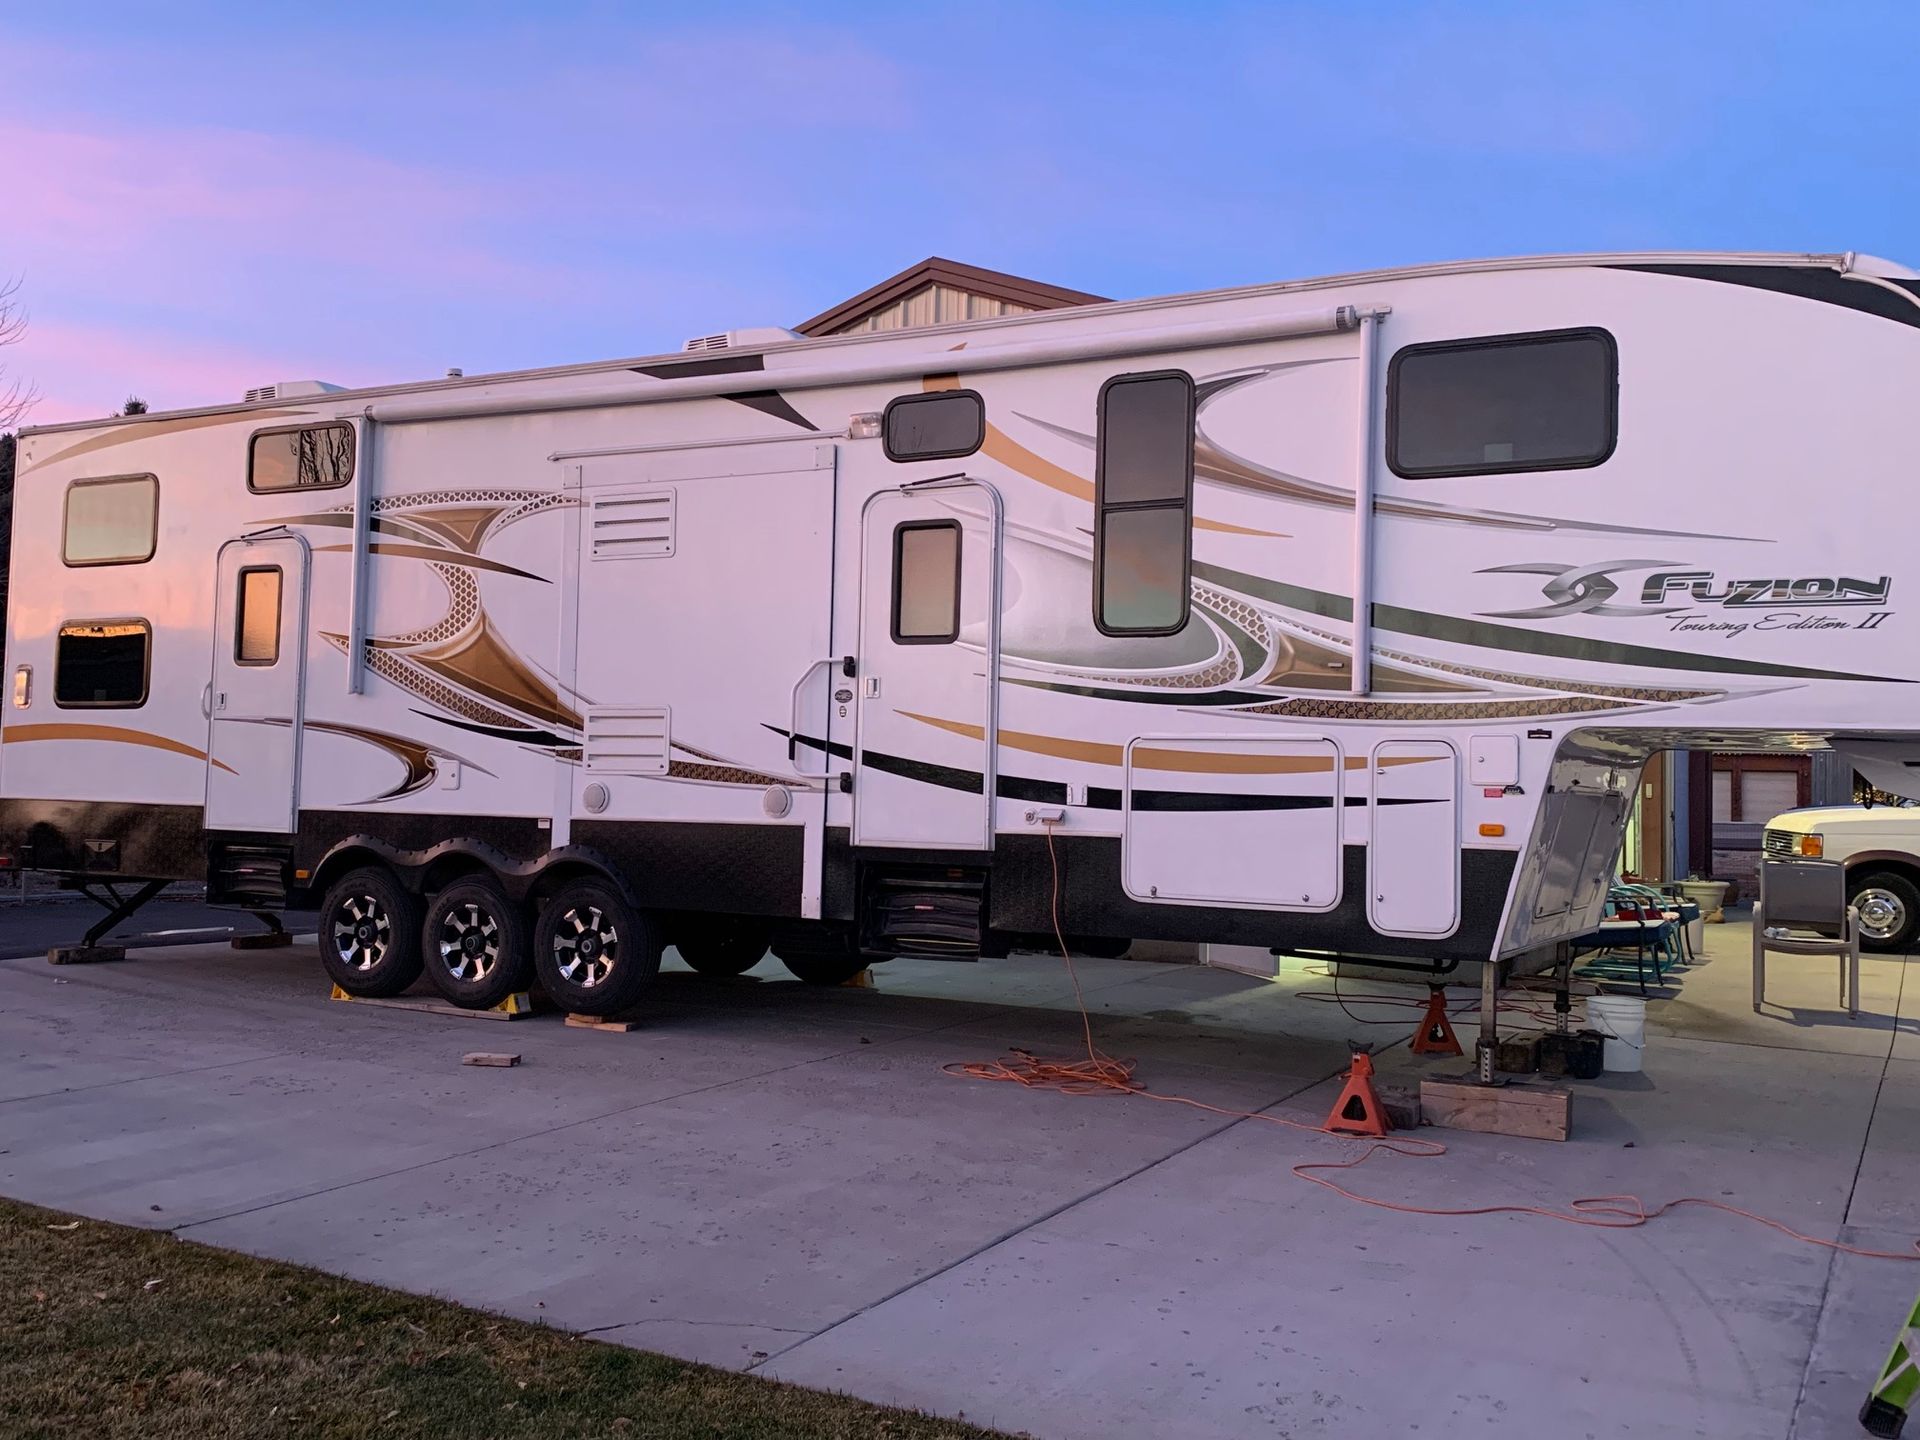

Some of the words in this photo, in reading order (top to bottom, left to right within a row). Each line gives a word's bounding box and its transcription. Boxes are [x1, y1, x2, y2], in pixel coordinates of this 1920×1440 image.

[1641, 572, 1892, 608] FUZION
[1665, 614, 1749, 639] Touring
[1753, 613, 1851, 630] Edition
[1853, 612, 1896, 629] II
